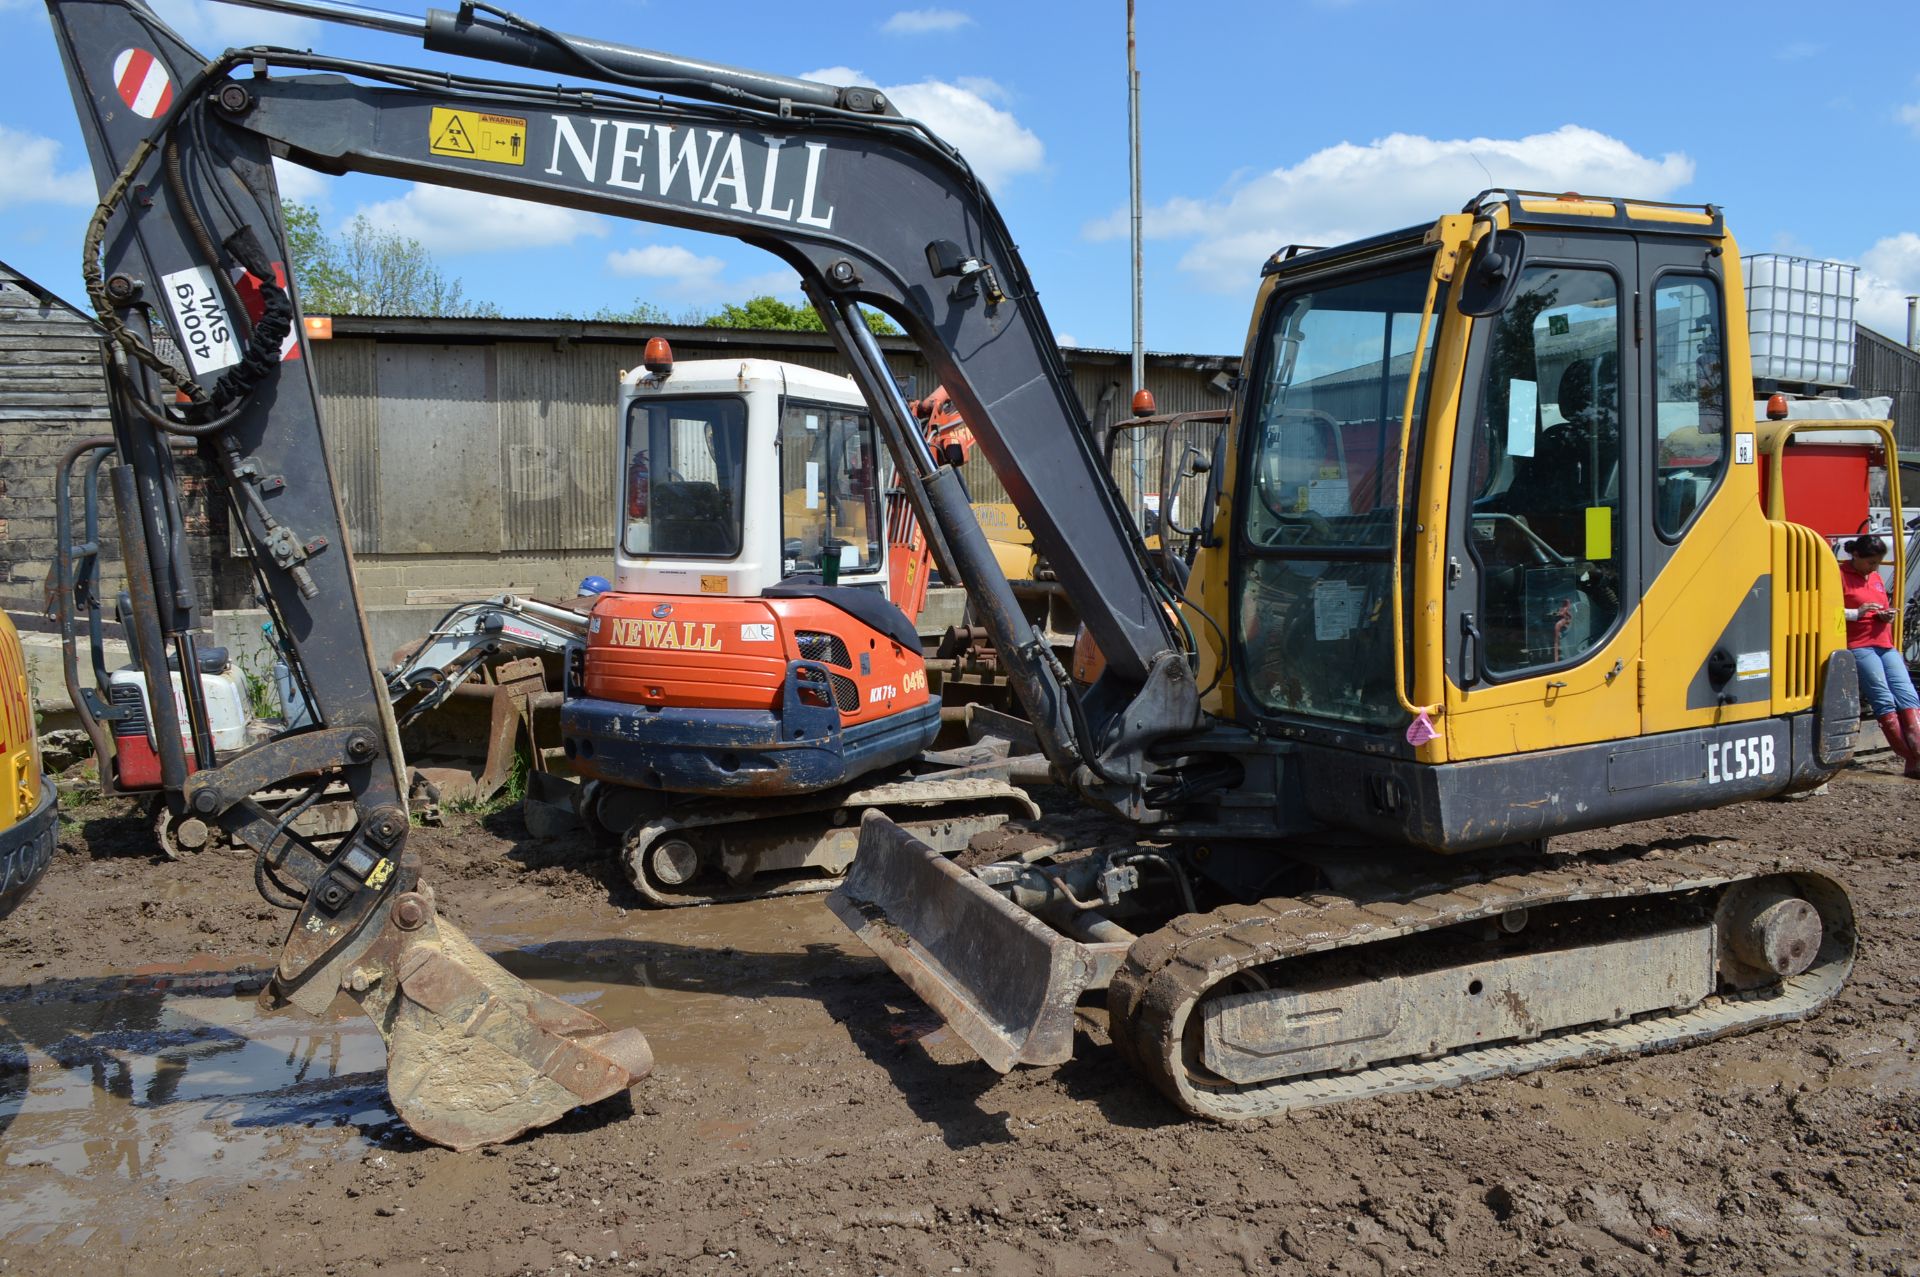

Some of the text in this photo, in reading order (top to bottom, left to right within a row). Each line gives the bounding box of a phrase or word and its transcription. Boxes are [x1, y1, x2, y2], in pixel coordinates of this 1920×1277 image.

[489, 116, 523, 126] WARNING
[544, 114, 834, 229] NEWALL
[175, 283, 211, 359] 400kg
[199, 287, 230, 344] SWL
[1739, 446, 1748, 462] 98
[609, 618, 722, 652] NEWALL
[903, 669, 926, 694] 0416
[1708, 735, 1775, 785] EC55B
